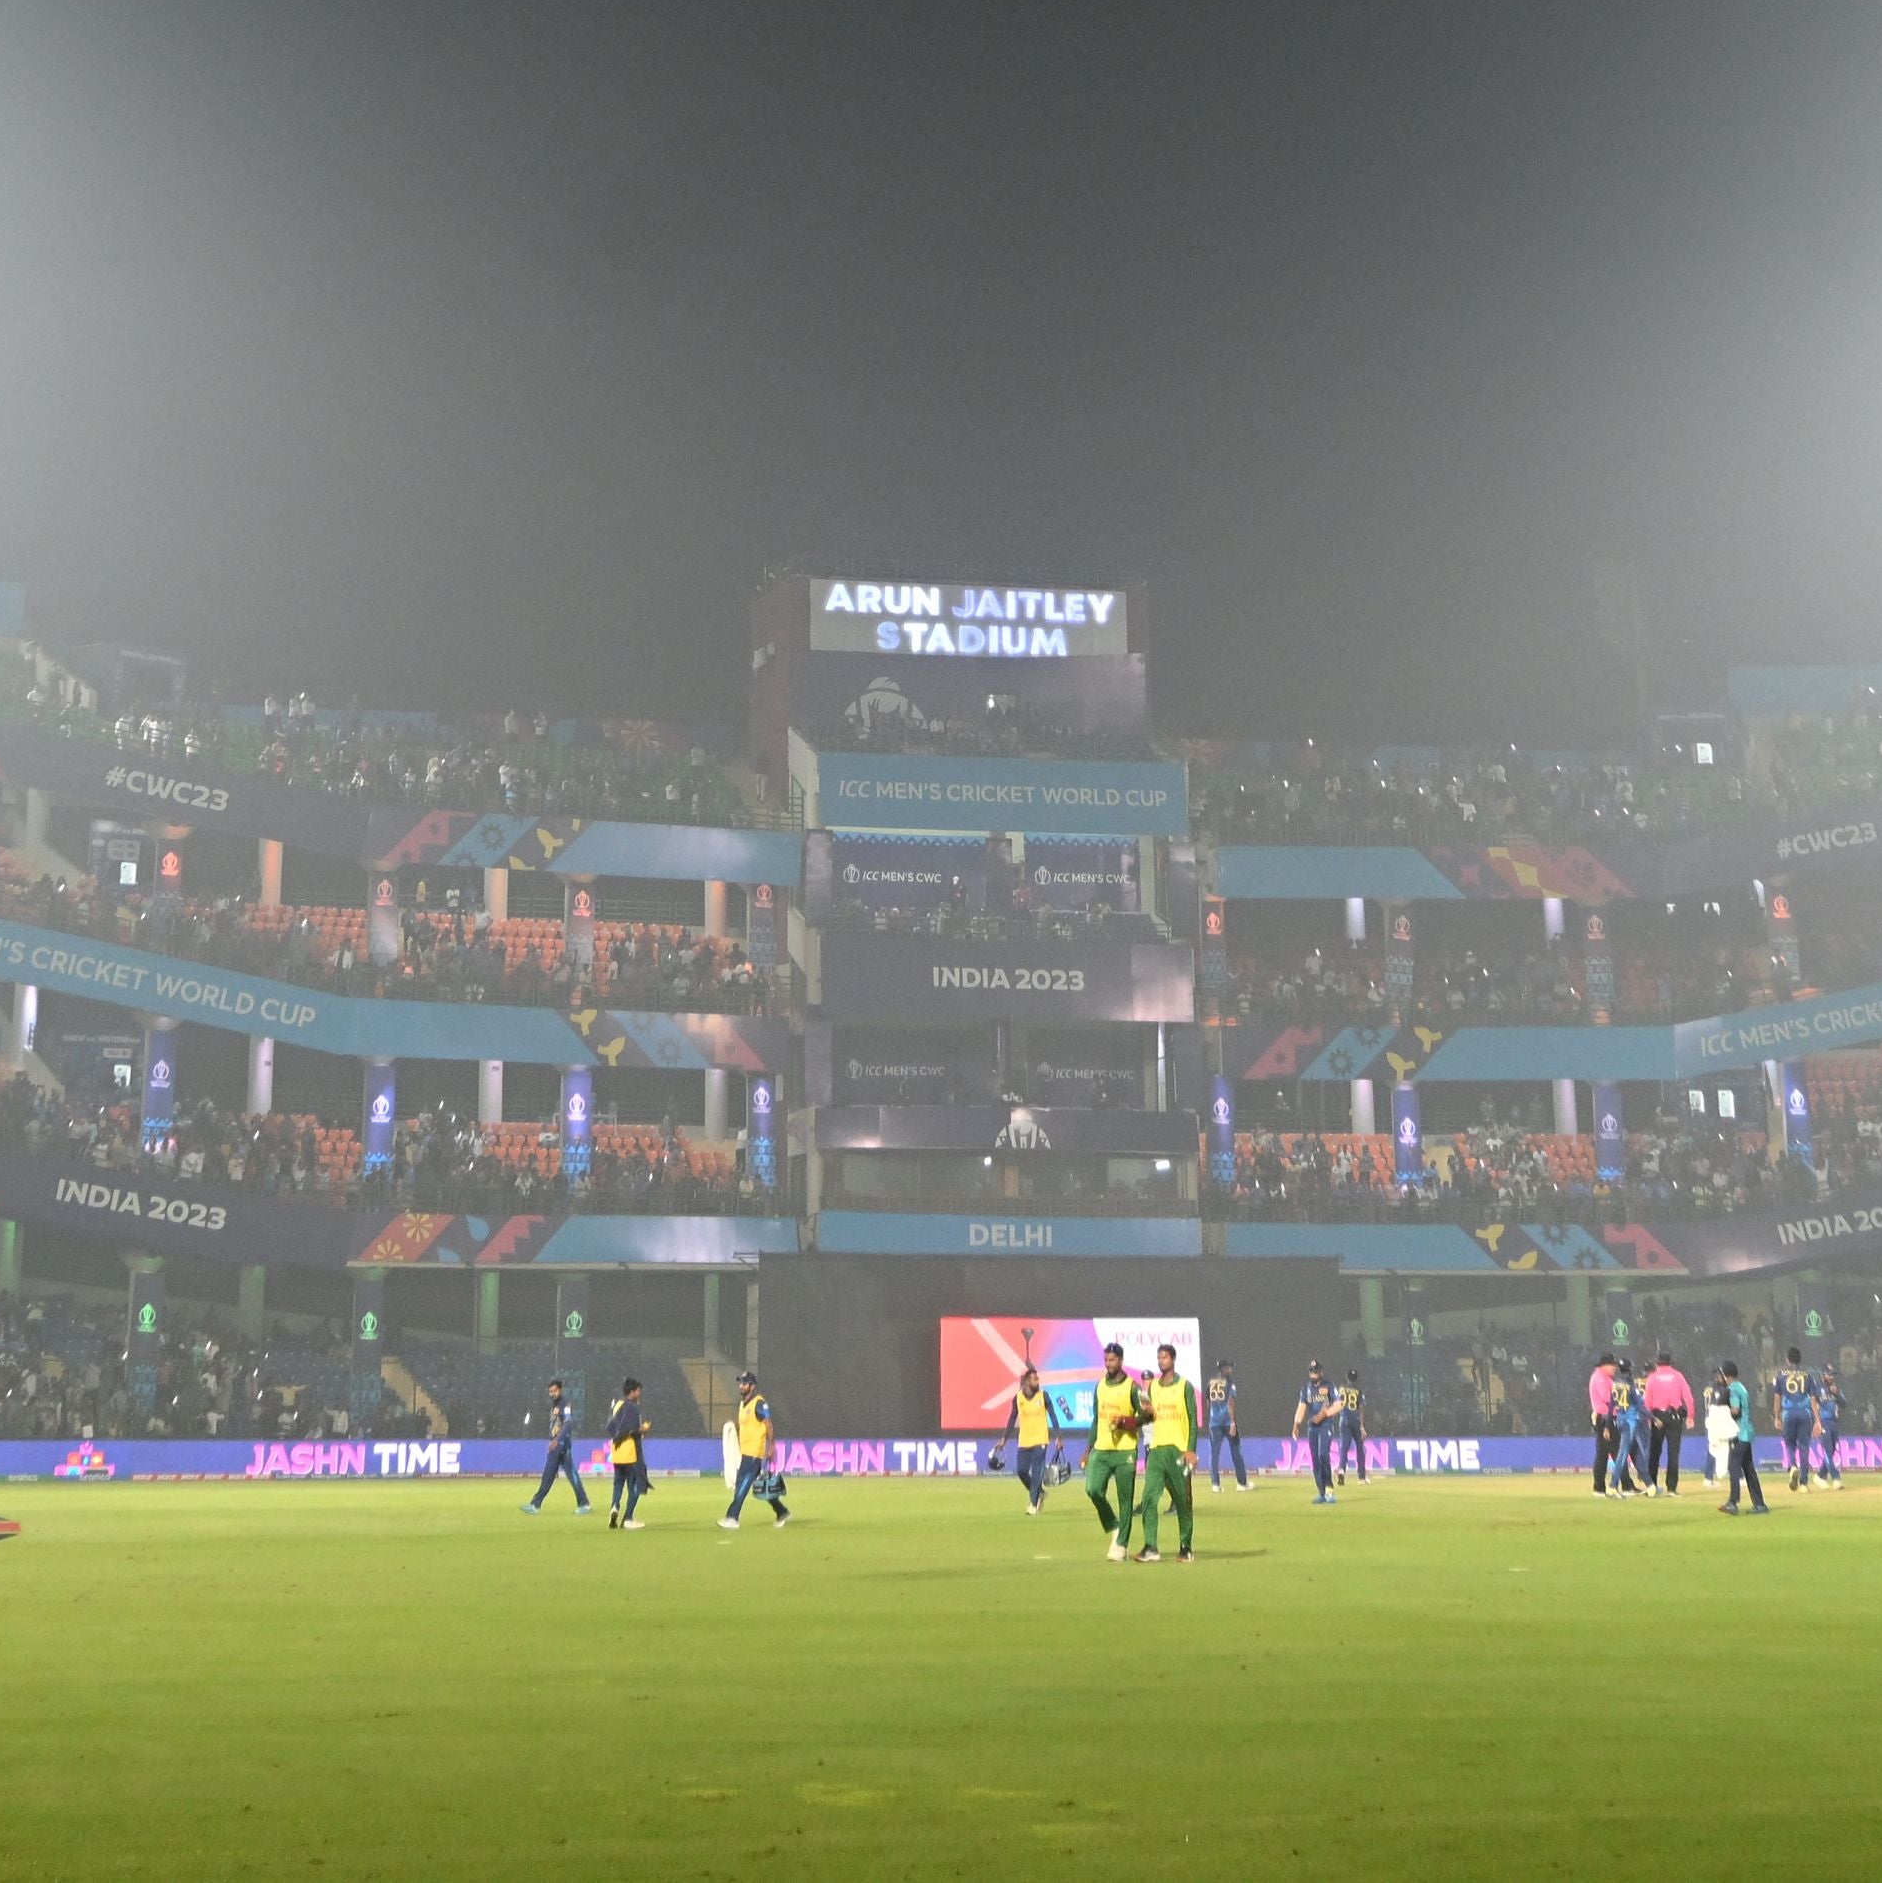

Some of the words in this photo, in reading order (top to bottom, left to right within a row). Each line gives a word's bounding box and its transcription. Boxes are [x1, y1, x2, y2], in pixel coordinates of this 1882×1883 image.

[825, 583, 941, 616] ARUN
[951, 589, 1114, 624] JAITLEY
[877, 621, 1069, 657] STADIUM
[105, 765, 230, 812] #CWC23
[838, 779, 871, 798] ICC
[876, 781, 942, 801] MEN'S
[946, 783, 1036, 804] CRICKET
[1041, 786, 1121, 807] WORLD
[1124, 789, 1168, 808] CUP
[1775, 822, 1878, 859] #CWC23
[862, 870, 879, 883] ICC
[881, 870, 914, 884] MEN'S
[916, 871, 942, 884] CWC
[1052, 871, 1070, 884] ICC
[1071, 871, 1104, 884] MEN'S
[31, 946, 149, 993] CRICKET
[155, 972, 255, 1016] WORLD
[259, 997, 316, 1030] CUP
[932, 966, 1011, 990] INDIA
[1014, 968, 1086, 992] 2023
[1700, 1030, 1735, 1058] ICC
[1739, 1016, 1811, 1050] MEN'S
[55, 1177, 141, 1216] INDIA
[146, 1194, 228, 1231] 2023
[968, 1222, 1053, 1249] DELHI
[1776, 1213, 1854, 1246] INDIA
[1115, 1331, 1193, 1346] POLYCAB
[1209, 1383, 1225, 1401] 65
[1786, 1374, 1805, 1394] 61
[246, 1442, 366, 1475] JASHN
[373, 1442, 461, 1474] TIME
[770, 1442, 885, 1473] JASHN
[893, 1442, 977, 1472] TIME
[1397, 1440, 1480, 1470] TIME
